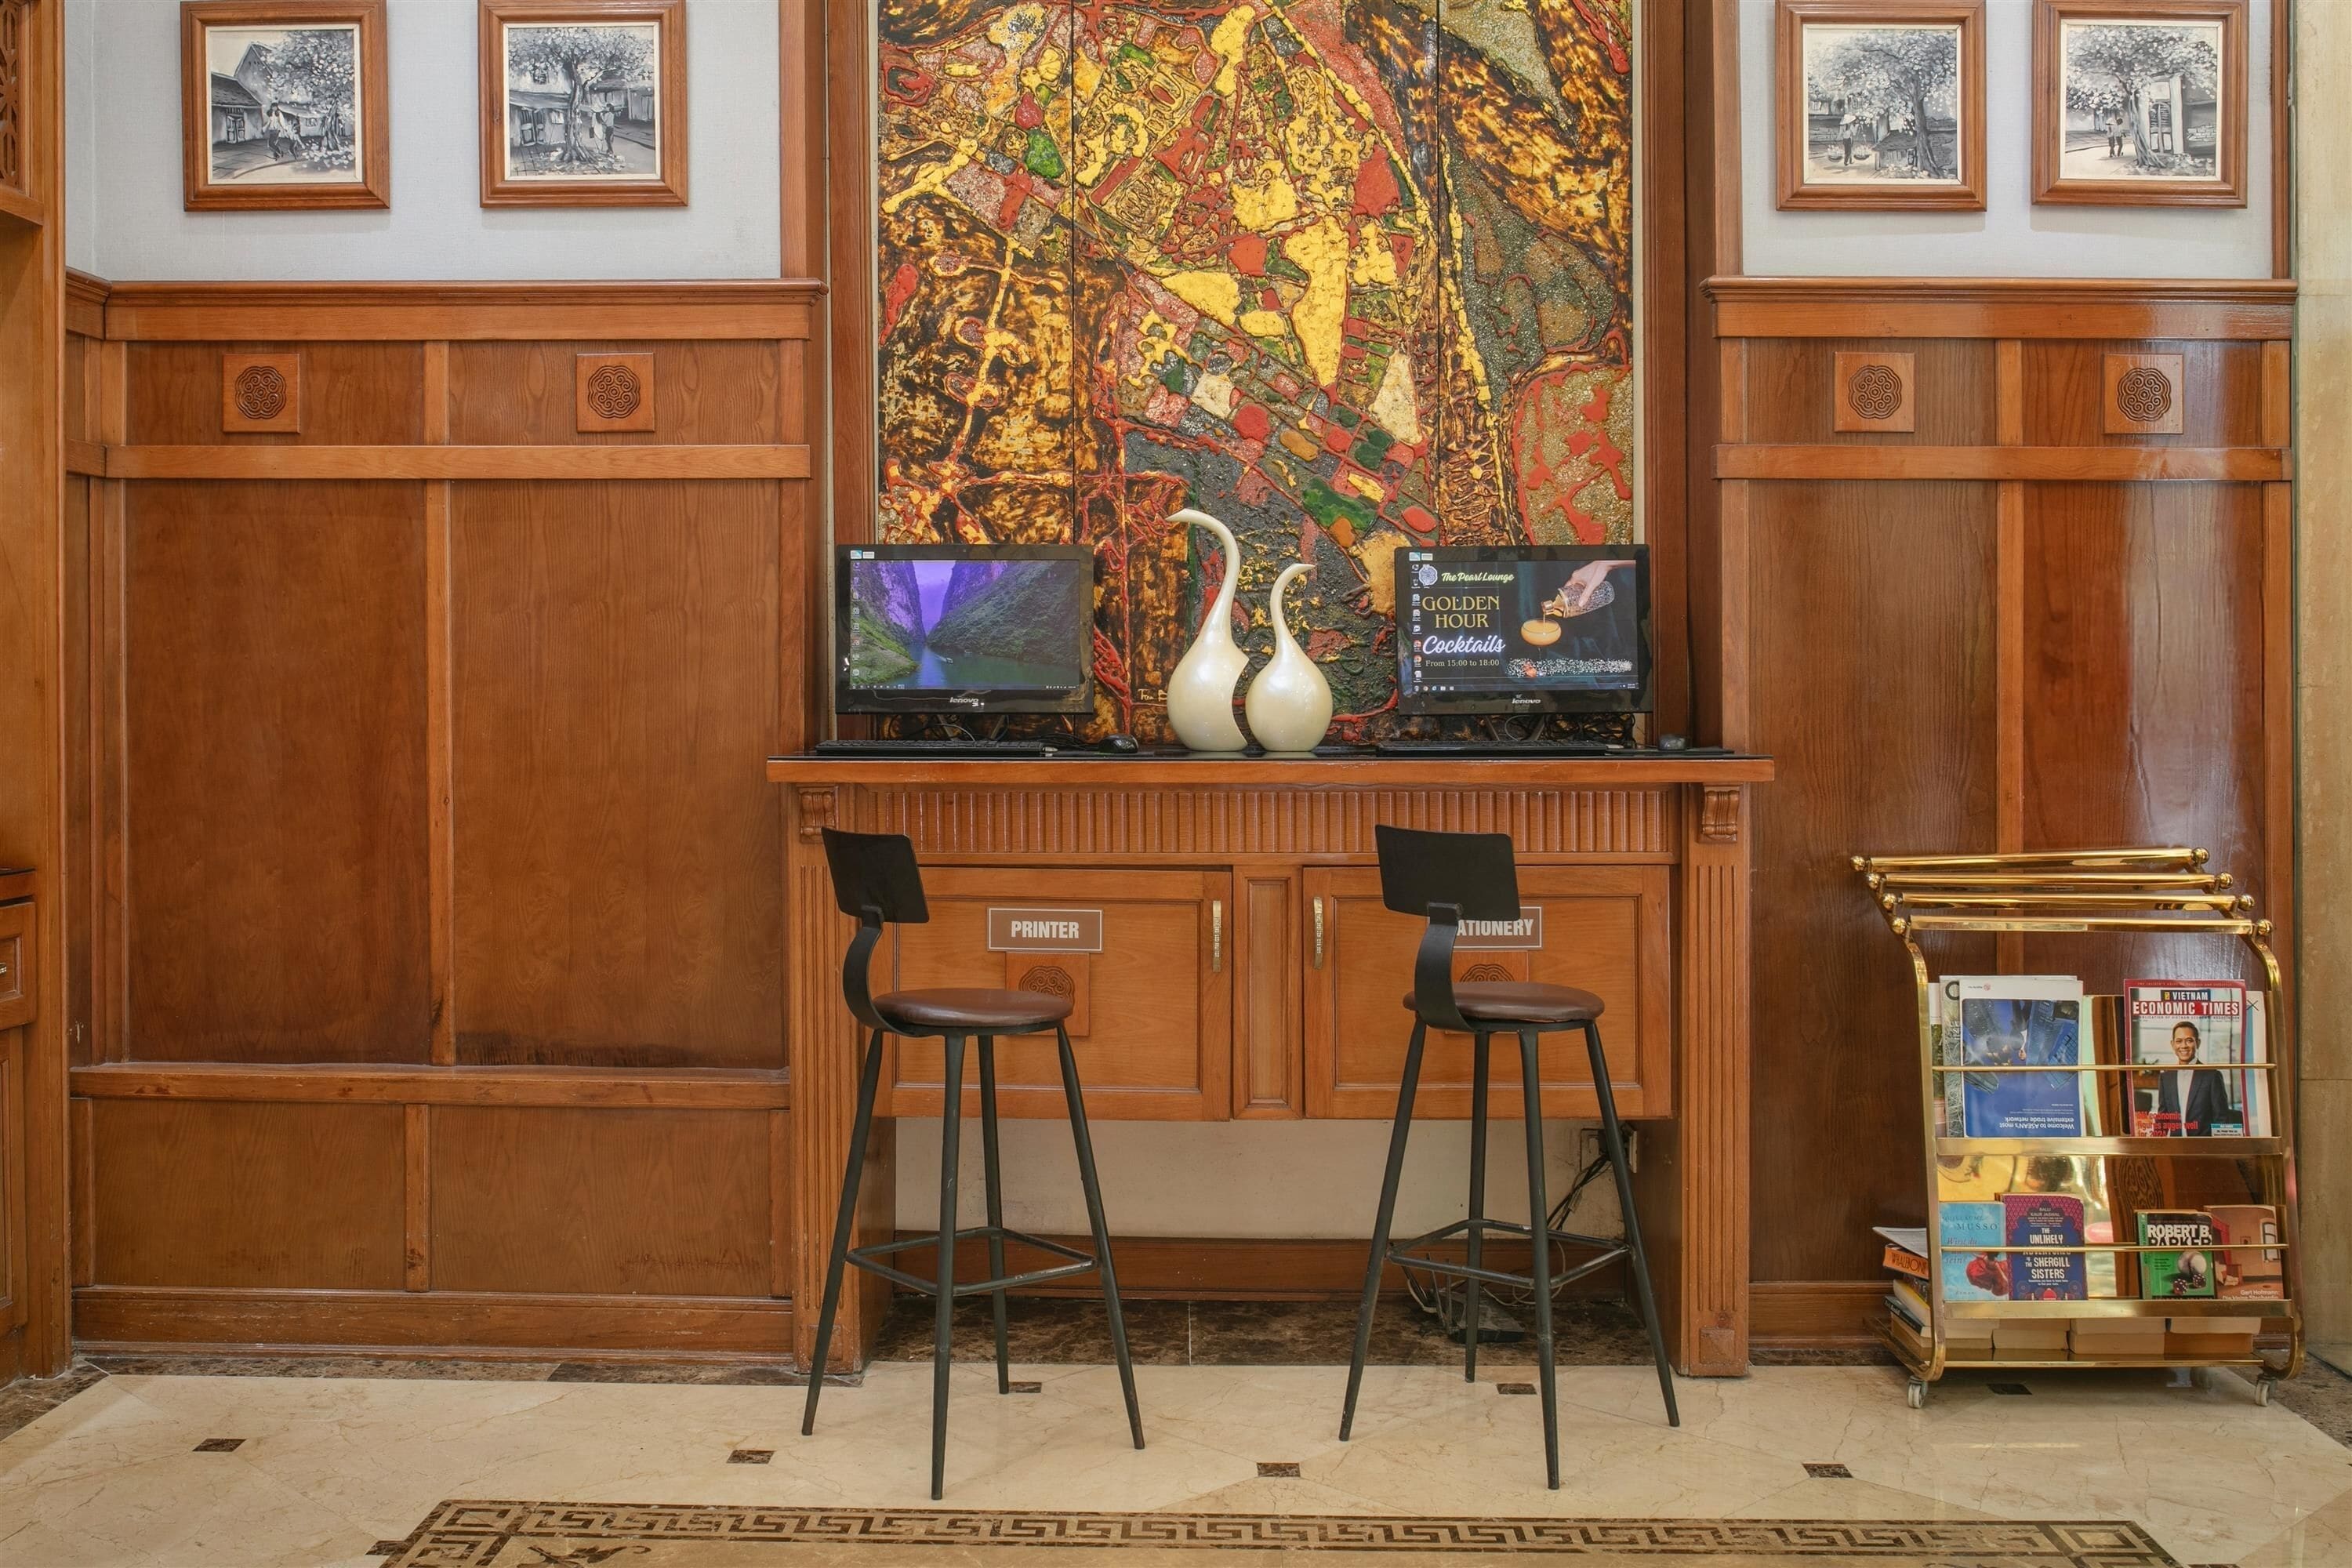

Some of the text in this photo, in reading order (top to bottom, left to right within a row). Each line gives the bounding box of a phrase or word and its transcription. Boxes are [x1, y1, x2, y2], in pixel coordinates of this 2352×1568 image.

[1441, 572, 1514, 583] The Pearl Lounge
[1421, 596, 1500, 611] GOLDEN
[1435, 613, 1489, 628] HOUR
[1422, 634, 1505, 654] Cocktails
[1011, 920, 1080, 938] PRINTER
[1457, 919, 1534, 936] ATIONERY
[2172, 991, 2208, 1000] VIETNAM
[2132, 1001, 2239, 1014] ECONOMIC TIMES
[2147, 1225, 2198, 1238] ROBERT
[2030, 1234, 2063, 1244] UNLIKELY
[2034, 1257, 2070, 1267] SHERGILL
[2031, 1269, 2065, 1279] SISTERS
